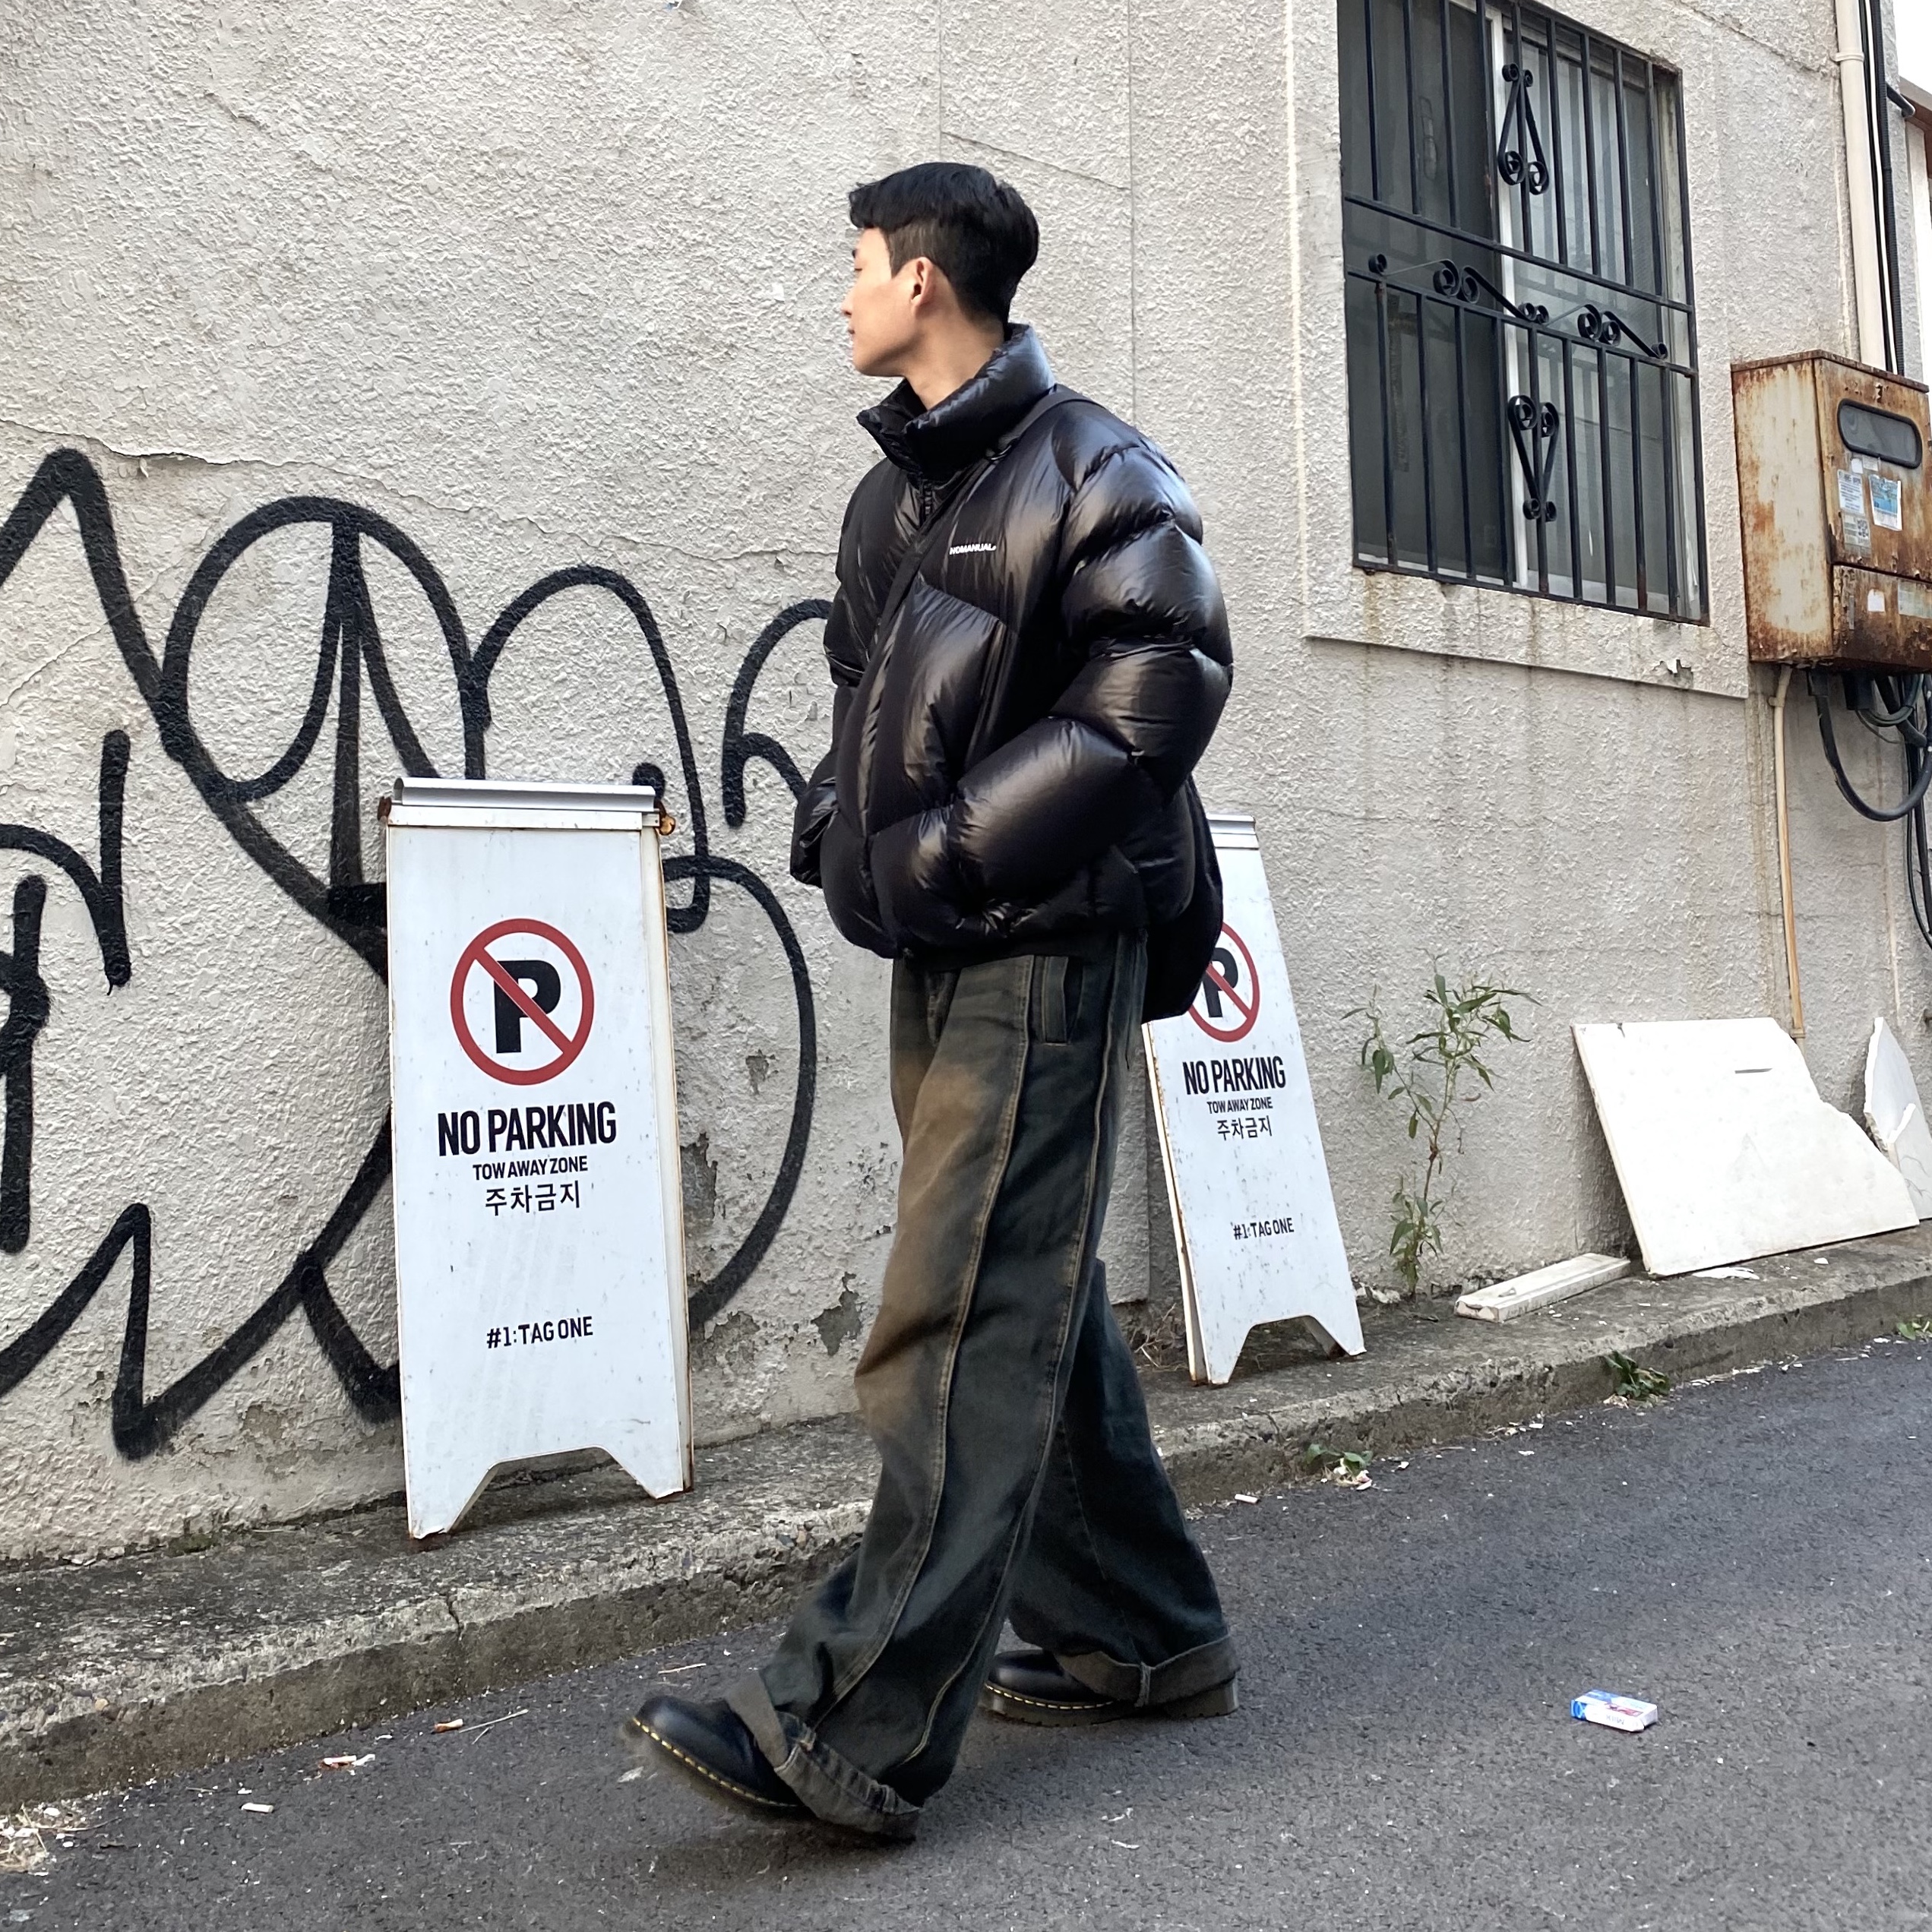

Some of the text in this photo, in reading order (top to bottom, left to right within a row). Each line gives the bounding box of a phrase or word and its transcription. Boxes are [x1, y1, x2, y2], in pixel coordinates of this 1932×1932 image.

[1182, 1055, 1286, 1096] NO PARKING
[1206, 1096, 1273, 1115] TOW AWAY ZONE
[438, 1101, 617, 1157] NO PARKING
[1216, 1115, 1273, 1141] 주차금지
[472, 1155, 588, 1181] TOW AWAY ZONE
[485, 1180, 581, 1216] 주차금지
[558, 1316, 593, 1339] ONE
